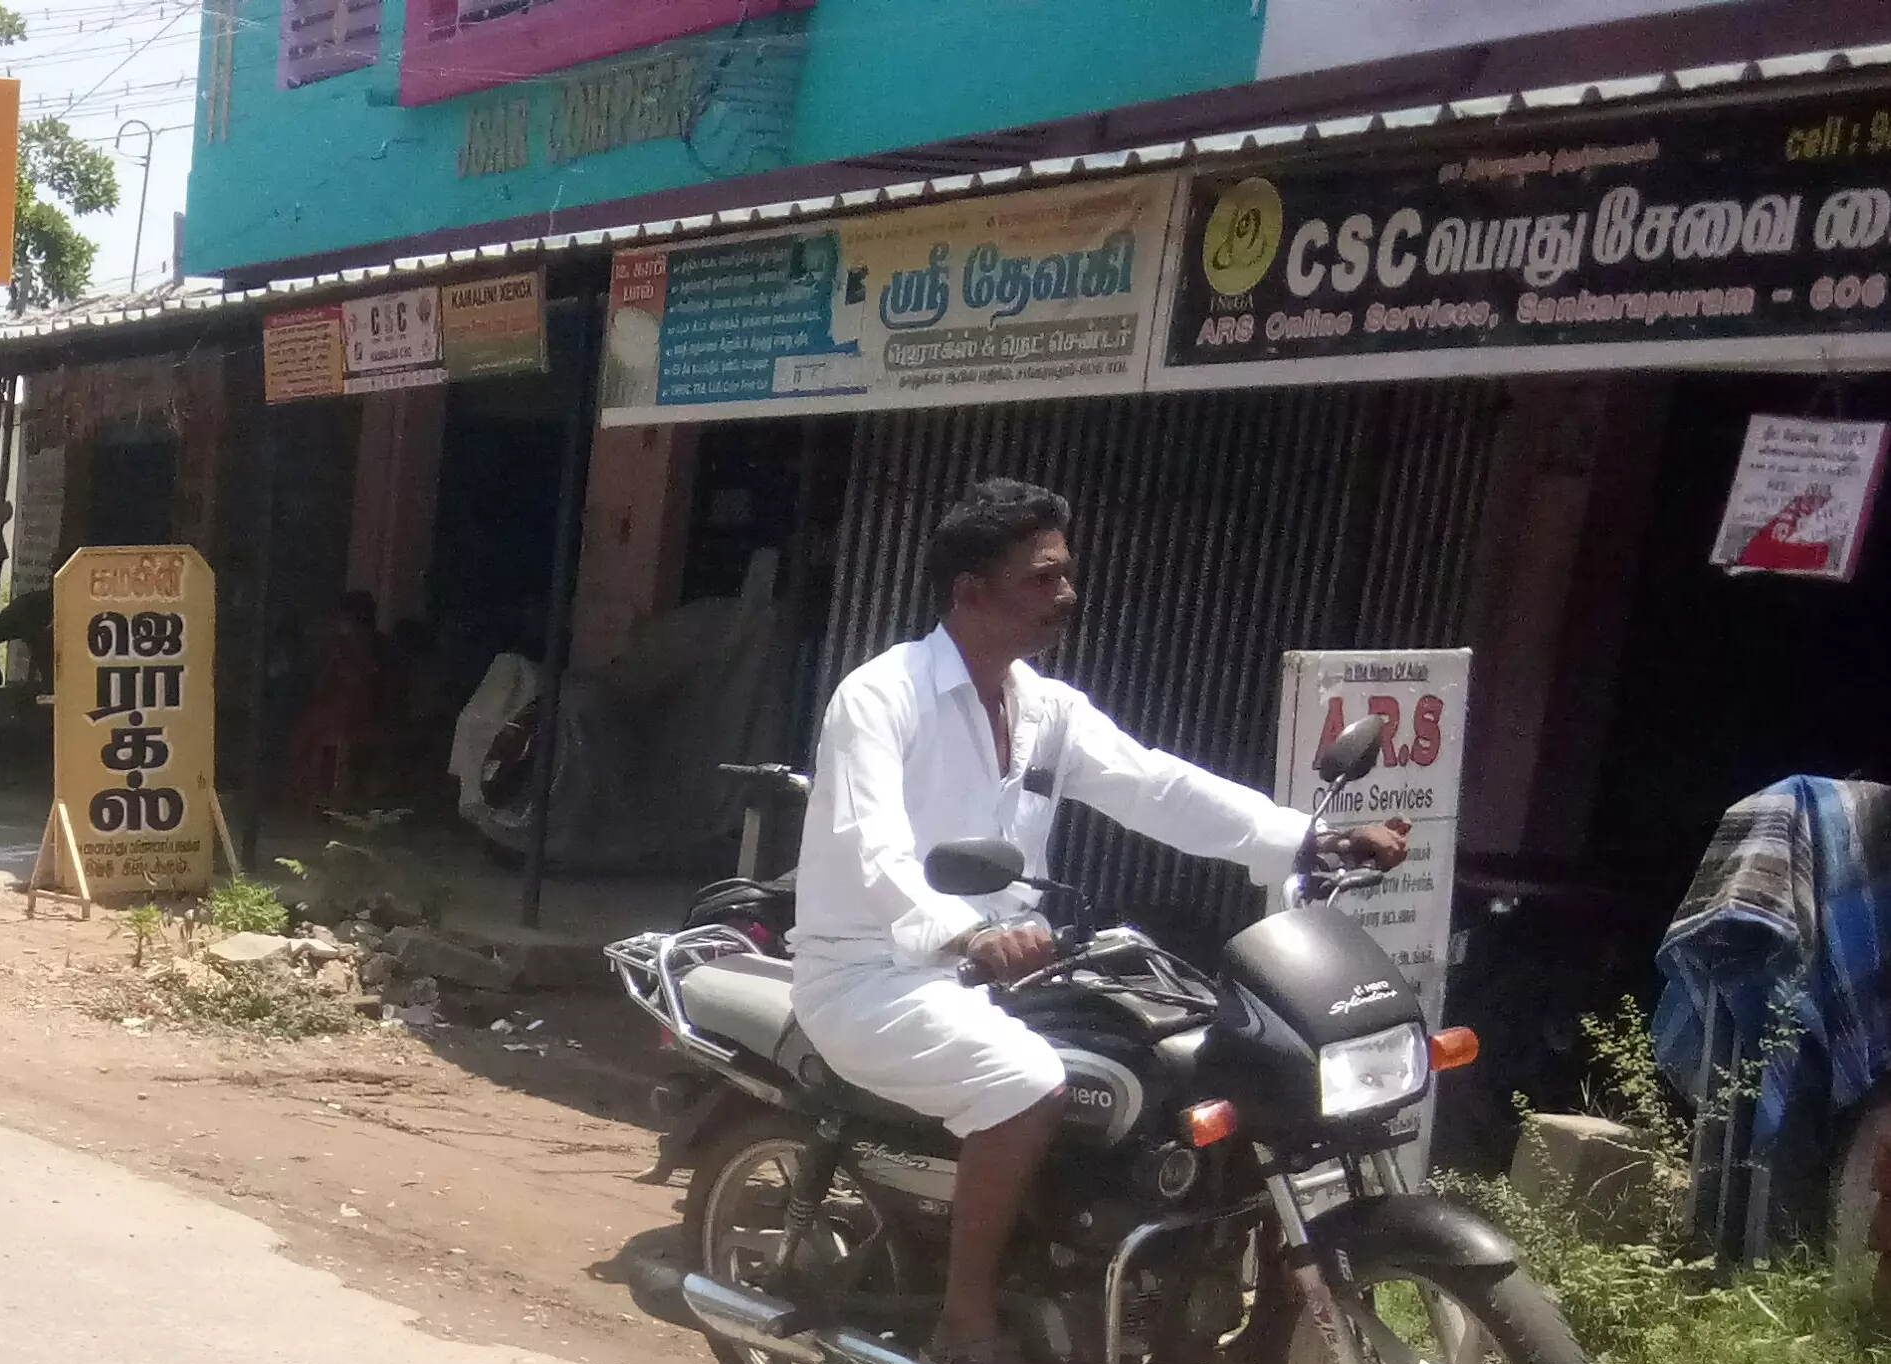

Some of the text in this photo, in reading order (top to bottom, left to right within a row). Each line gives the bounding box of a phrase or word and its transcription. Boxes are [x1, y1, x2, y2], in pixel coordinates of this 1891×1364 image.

[1196, 314, 1256, 347] ARS
[1265, 309, 1353, 342] Online
[1368, 783, 1434, 813] Services
